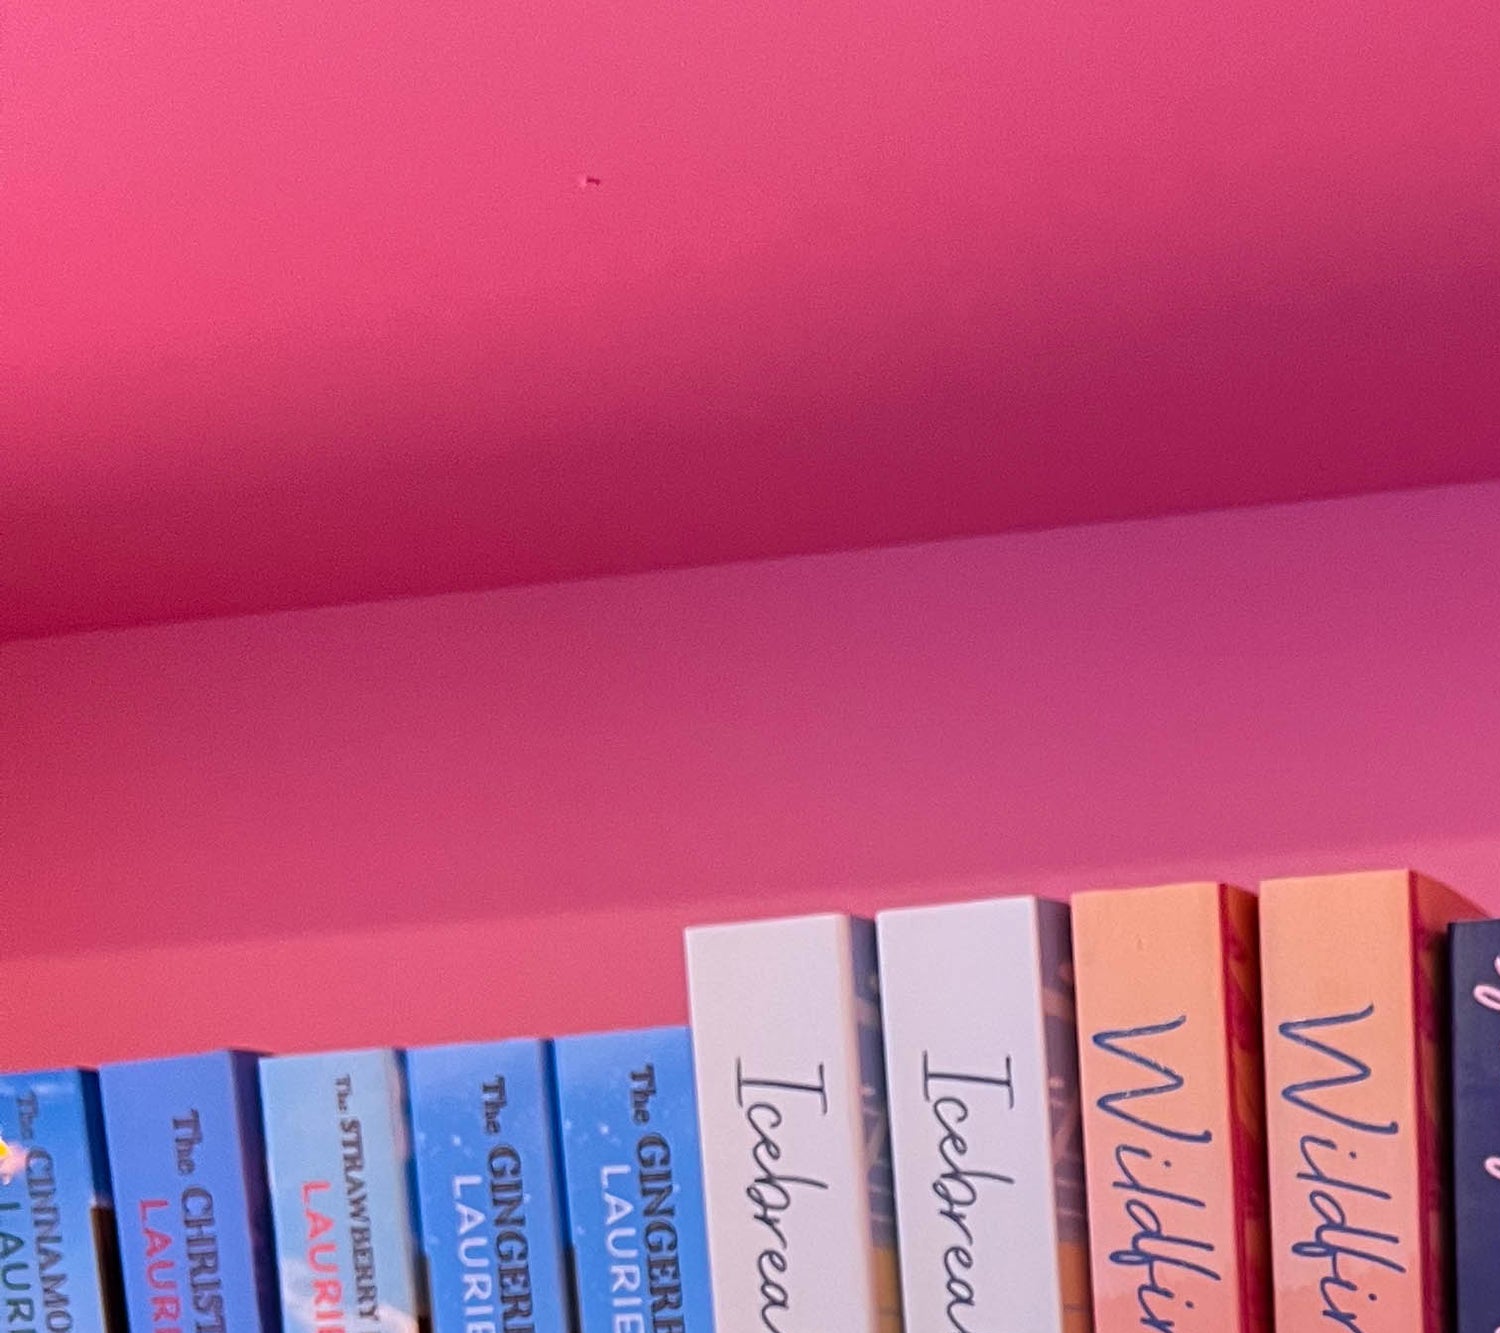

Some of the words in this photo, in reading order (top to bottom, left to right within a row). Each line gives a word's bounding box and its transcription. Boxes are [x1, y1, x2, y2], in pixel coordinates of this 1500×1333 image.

[481, 1075, 507, 1134] The
[629, 1064, 655, 1126] The
[171, 1109, 203, 1176] The
[341, 1118, 381, 1325] STRAWBERRY
